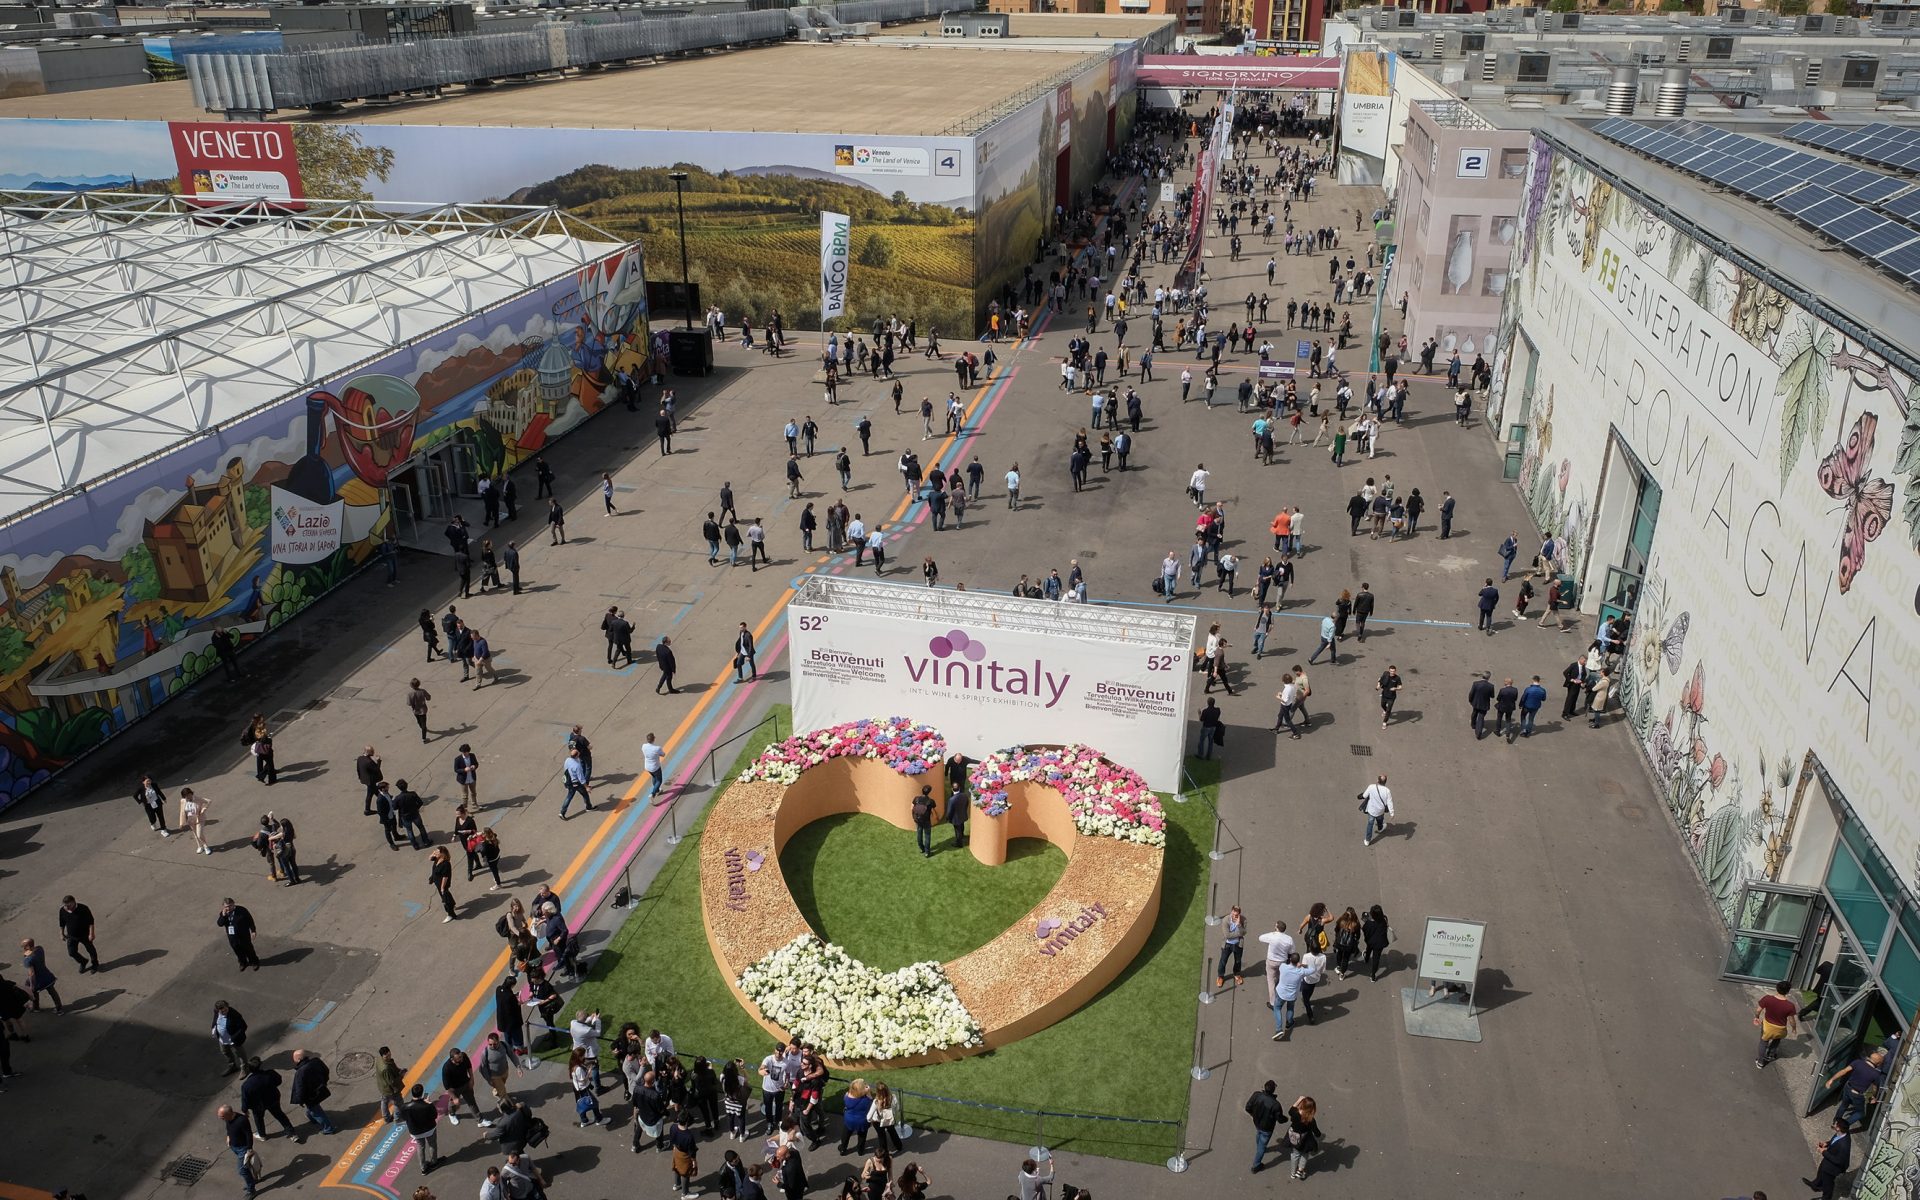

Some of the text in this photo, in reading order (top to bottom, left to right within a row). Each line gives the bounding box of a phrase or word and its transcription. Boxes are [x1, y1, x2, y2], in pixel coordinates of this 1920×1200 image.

[1182, 70, 1293, 79] SIGNORVINO
[1353, 102, 1385, 110] UMBRIA
[182, 130, 283, 160] VENETO
[940, 156, 955, 169] 4
[1465, 156, 1482, 170] 2
[229, 173, 249, 181] Veneto
[828, 222, 847, 311] BANCO BPM
[272, 543, 286, 555] UNA
[288, 541, 308, 554] STORIA
[317, 541, 336, 552] SAPORI
[811, 649, 884, 668] Benvenuti
[850, 668, 885, 679] Welcome
[904, 656, 1071, 709] vinitaly
[931, 690, 951, 698] WINE
[961, 694, 990, 703] SPIRITS
[993, 697, 1040, 709] EXHIBITION
[1096, 682, 1176, 702] Benvenuti
[1138, 702, 1175, 713] Welcome
[724, 847, 752, 912] vinitaly
[1039, 900, 1108, 957] vinitaly
[348, 1132, 372, 1156] Food
[371, 1122, 408, 1160] Restroo
[395, 1146, 416, 1165] Info
